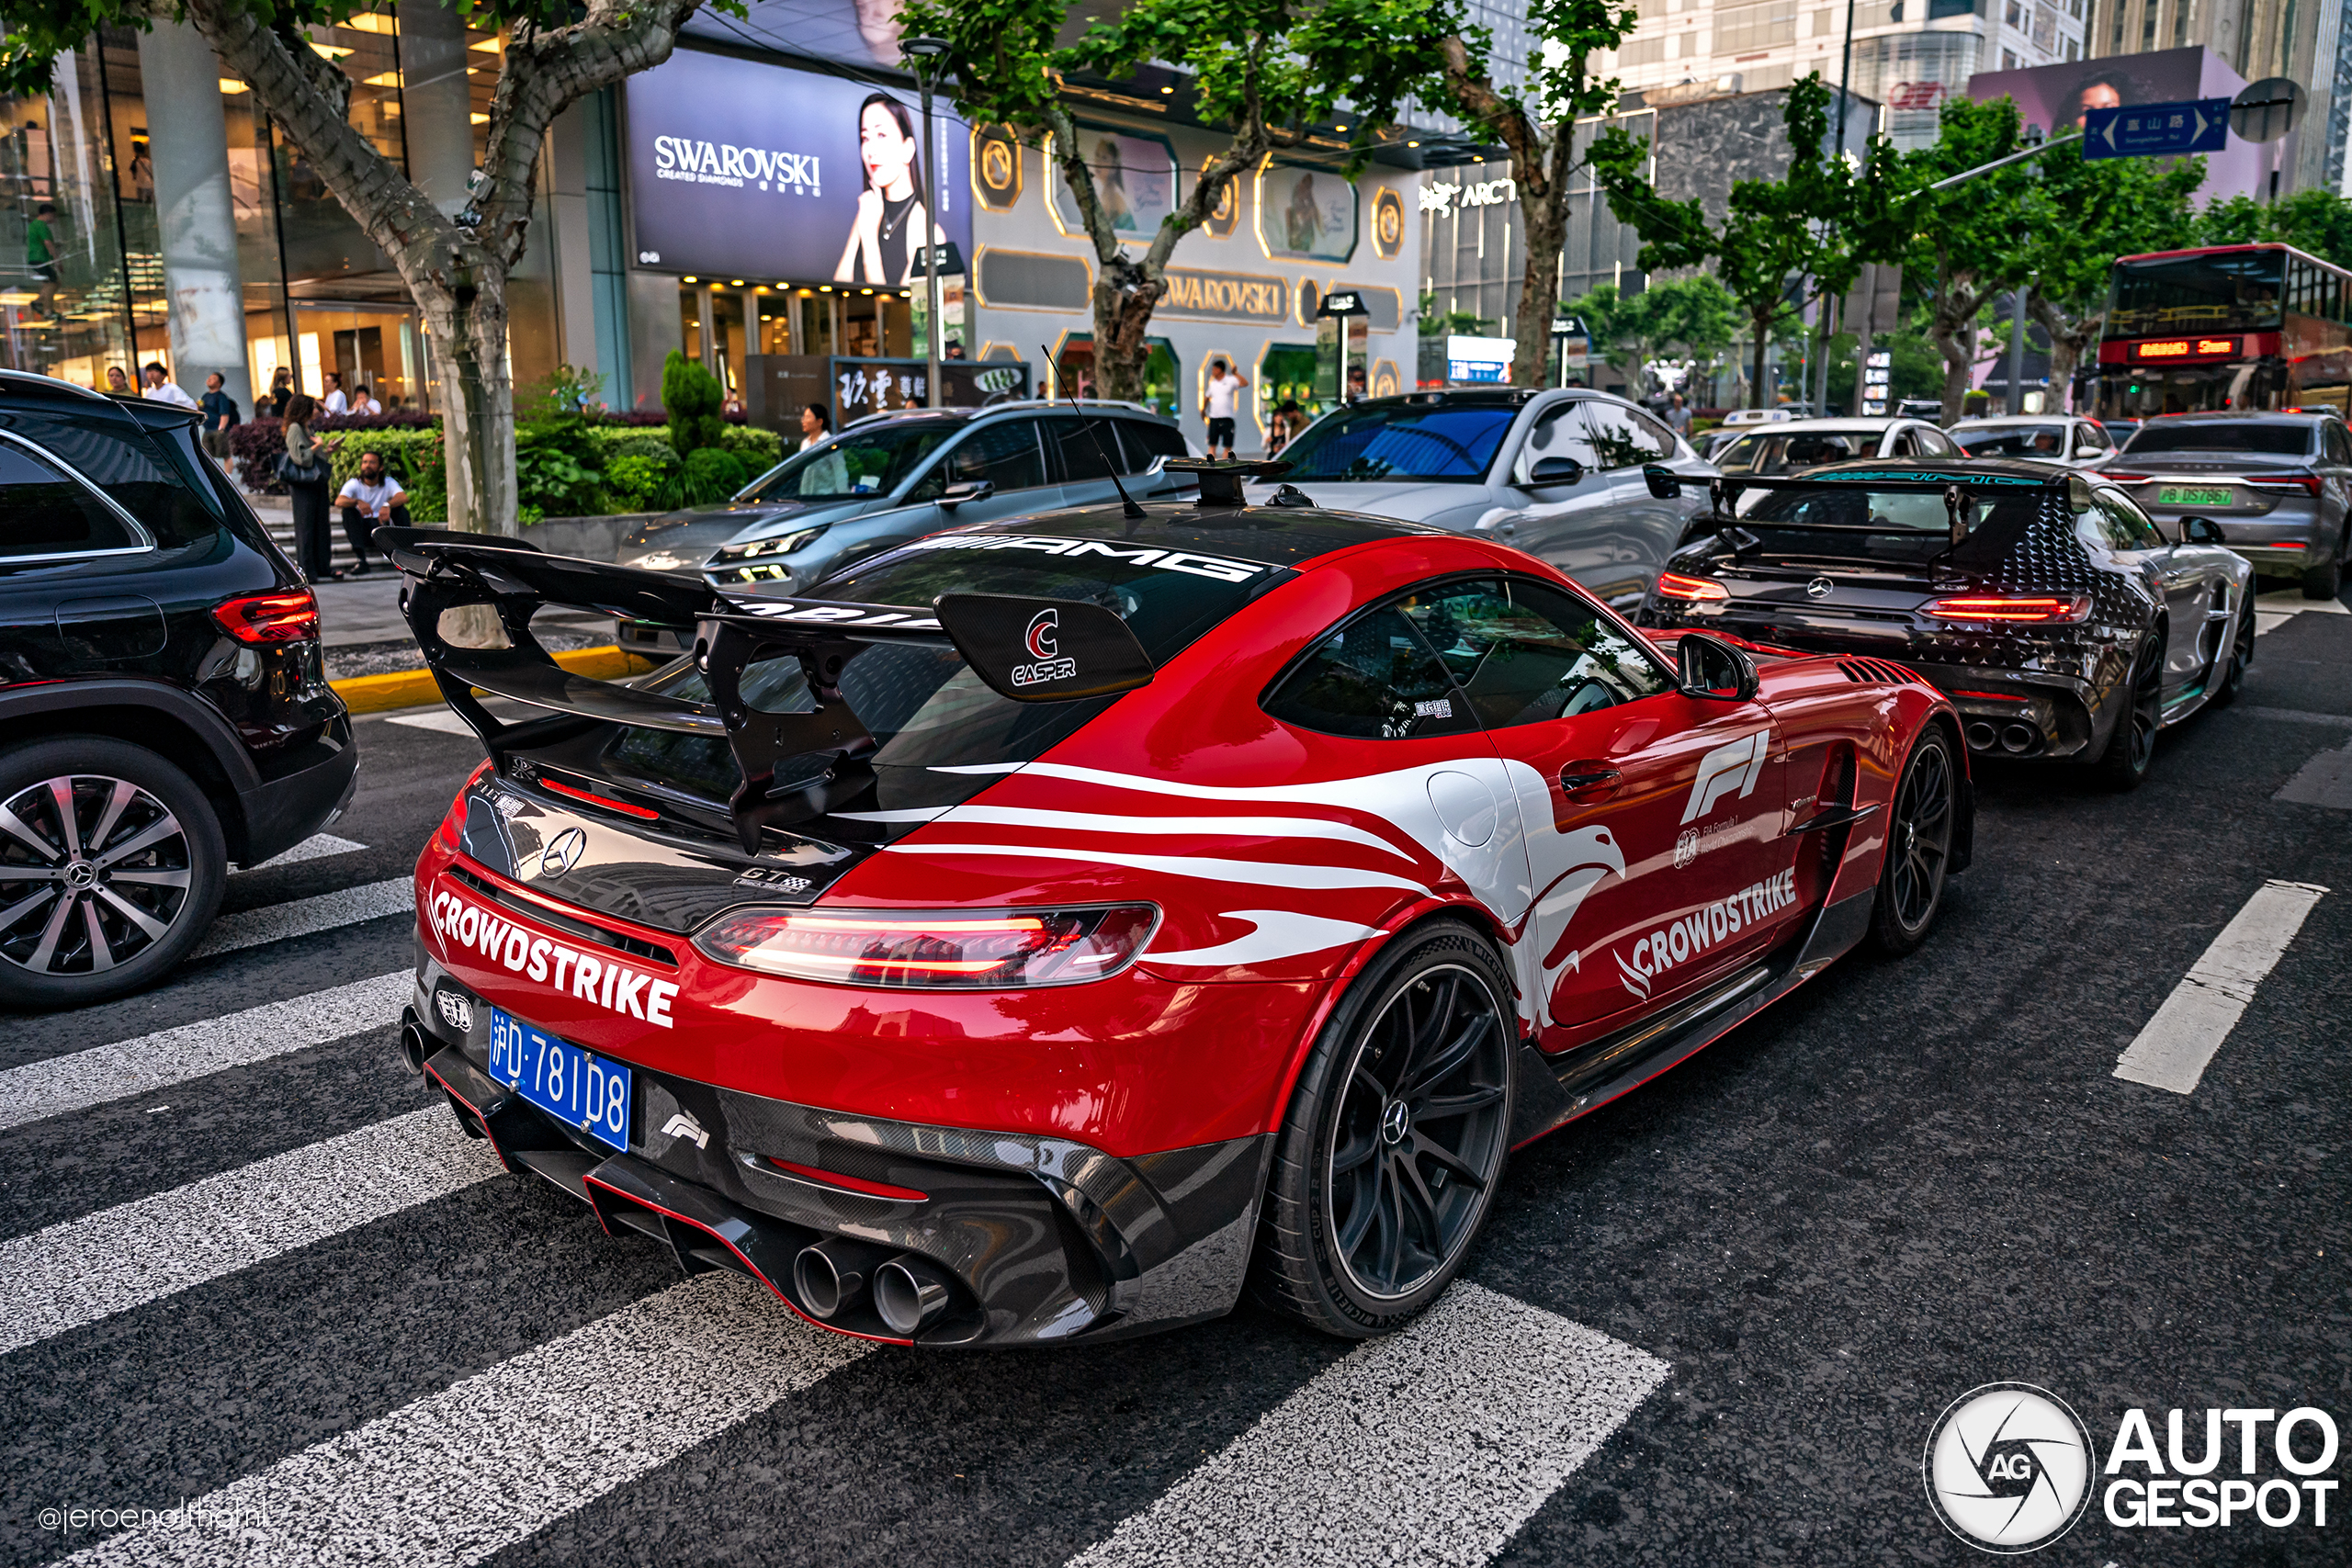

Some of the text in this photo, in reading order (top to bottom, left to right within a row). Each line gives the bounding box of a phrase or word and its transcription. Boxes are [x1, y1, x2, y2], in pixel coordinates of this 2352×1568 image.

[654, 135, 820, 186] SWAROVSKI
[656, 168, 743, 187] CREATED DIAMONDS
[1012, 657, 1076, 687] CASPER
[1701, 825, 1755, 854] World Championship
[1703, 825, 1713, 837] FIA
[1713, 818, 1736, 834] Formula
[1674, 833, 1697, 863] FIA
[741, 867, 790, 882] GT
[1633, 865, 1796, 977] CROWDSTRIKE
[435, 891, 680, 1029] CROWDSTRIKE
[440, 994, 471, 1028] FIA
[1311, 1179, 1320, 1189] R
[1311, 1196, 1319, 1204] 2
[1311, 1211, 1321, 1239] CUP
[1325, 1276, 1375, 1325] MICHELIN
